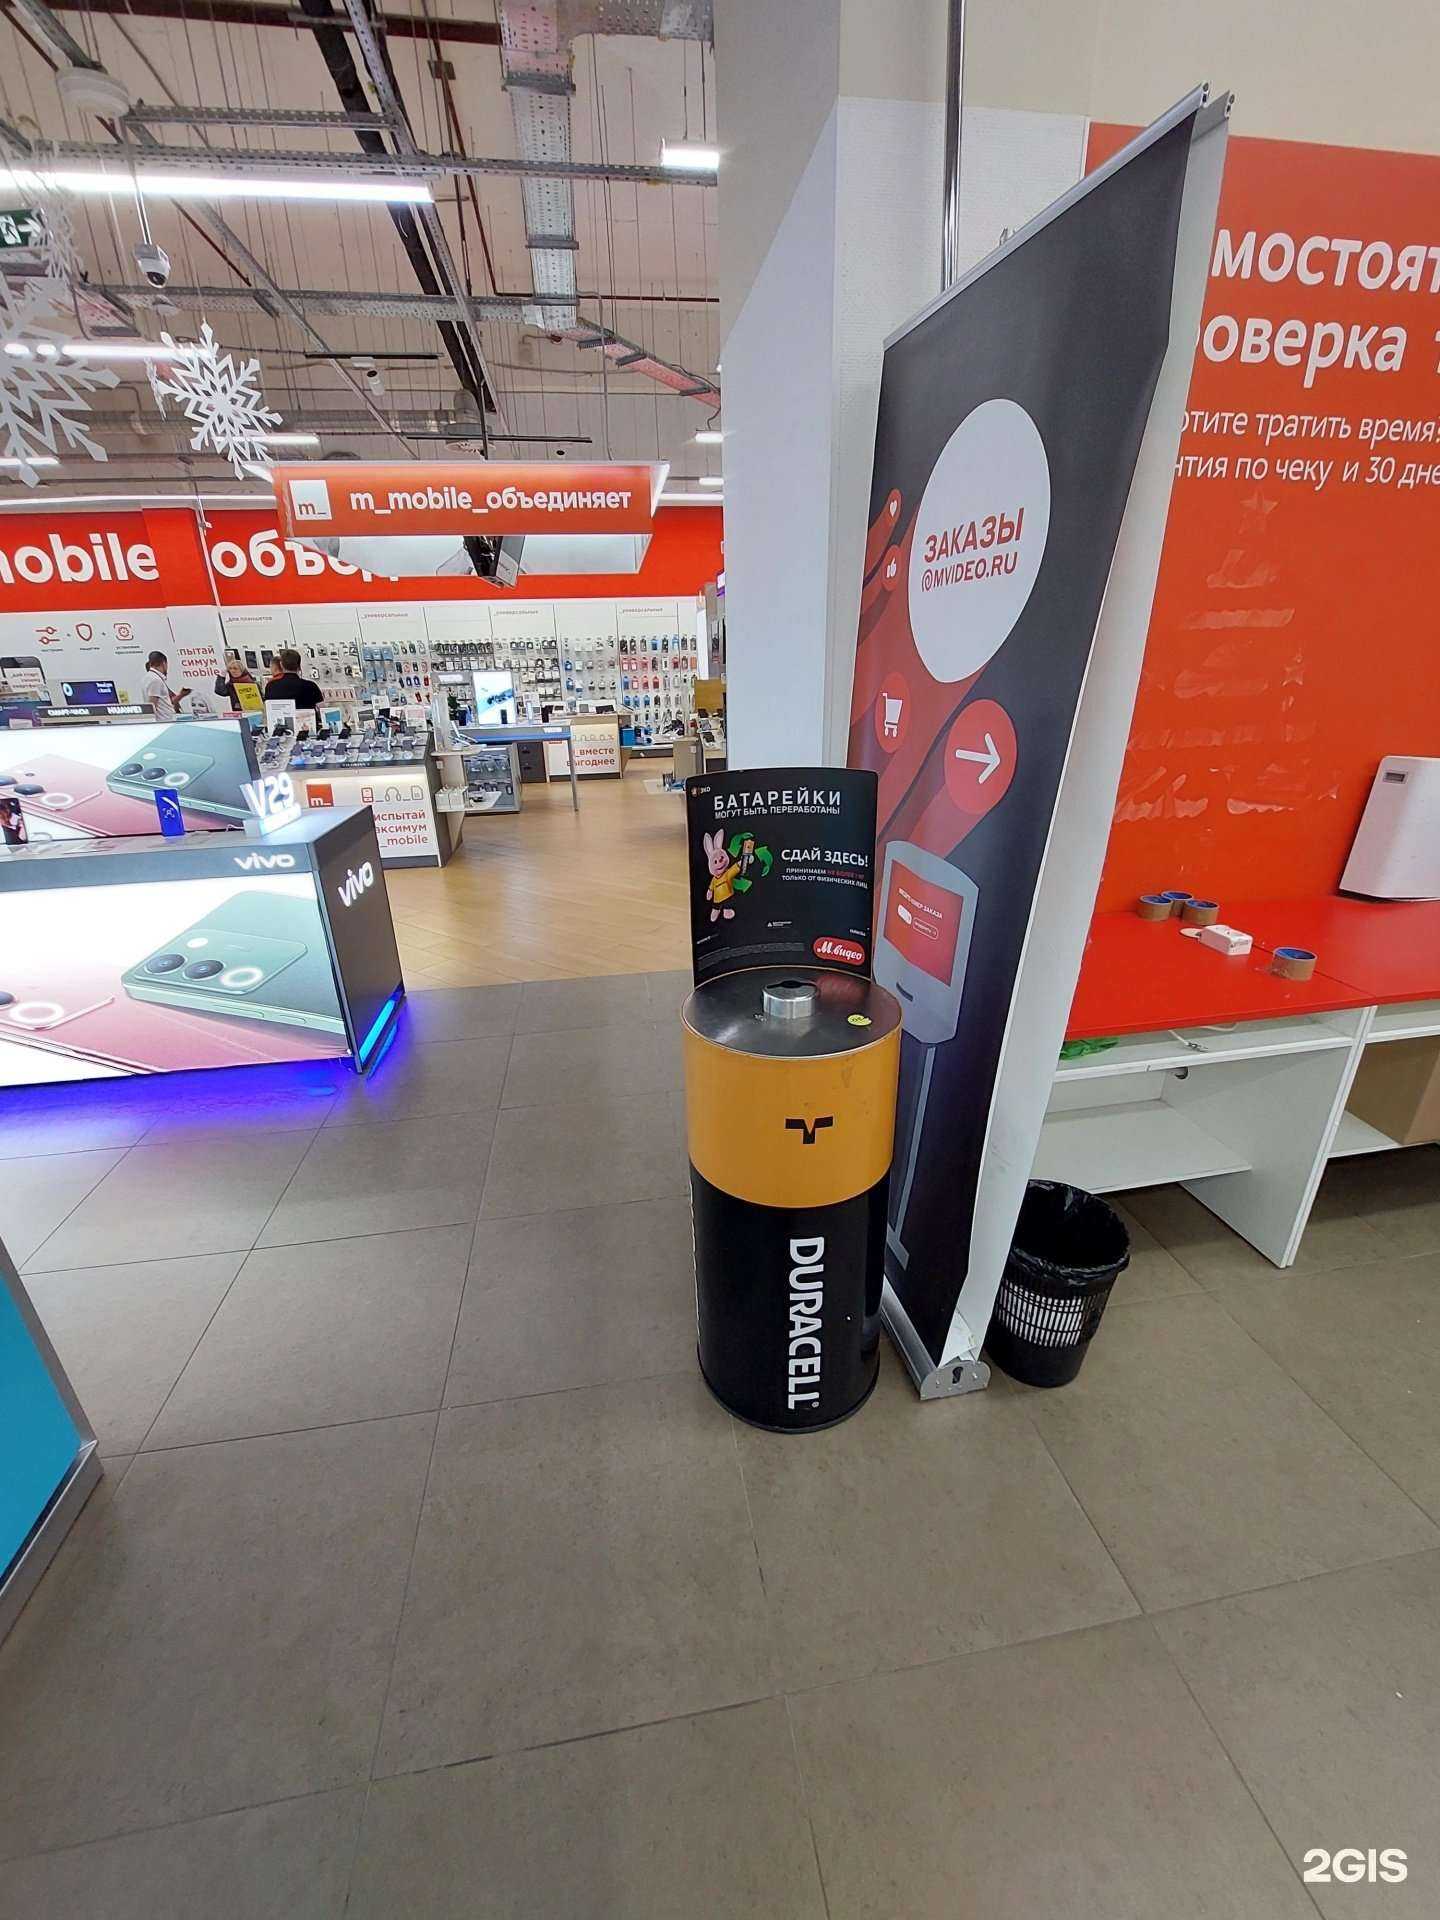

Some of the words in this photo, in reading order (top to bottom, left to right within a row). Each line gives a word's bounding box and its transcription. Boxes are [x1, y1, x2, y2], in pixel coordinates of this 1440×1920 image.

[1203, 315, 1407, 388] оверка
[1255, 412, 1351, 446] тратить
[1235, 457, 1268, 480] по
[1276, 459, 1333, 491] чеку
[1342, 463, 1360, 483] и
[1365, 457, 1396, 484] 30
[350, 486, 632, 514] m_mobile_объединяет
[924, 508, 1025, 563] ЗАКАЗЫ
[713, 787, 841, 811] БАТАРЕЙКИ
[714, 808, 742, 820] МОГУТ
[743, 805, 768, 816] БЫТЬ
[769, 804, 840, 816] ПЕРЕРАБОТАНЫ
[234, 852, 296, 870] vivo
[781, 847, 821, 862] СДАЙ
[823, 850, 869, 868] ЗДЕСЬ!
[337, 861, 374, 908] vivo
[816, 940, 863, 962] М.видео
[787, 1235, 826, 1411] DURACELL
